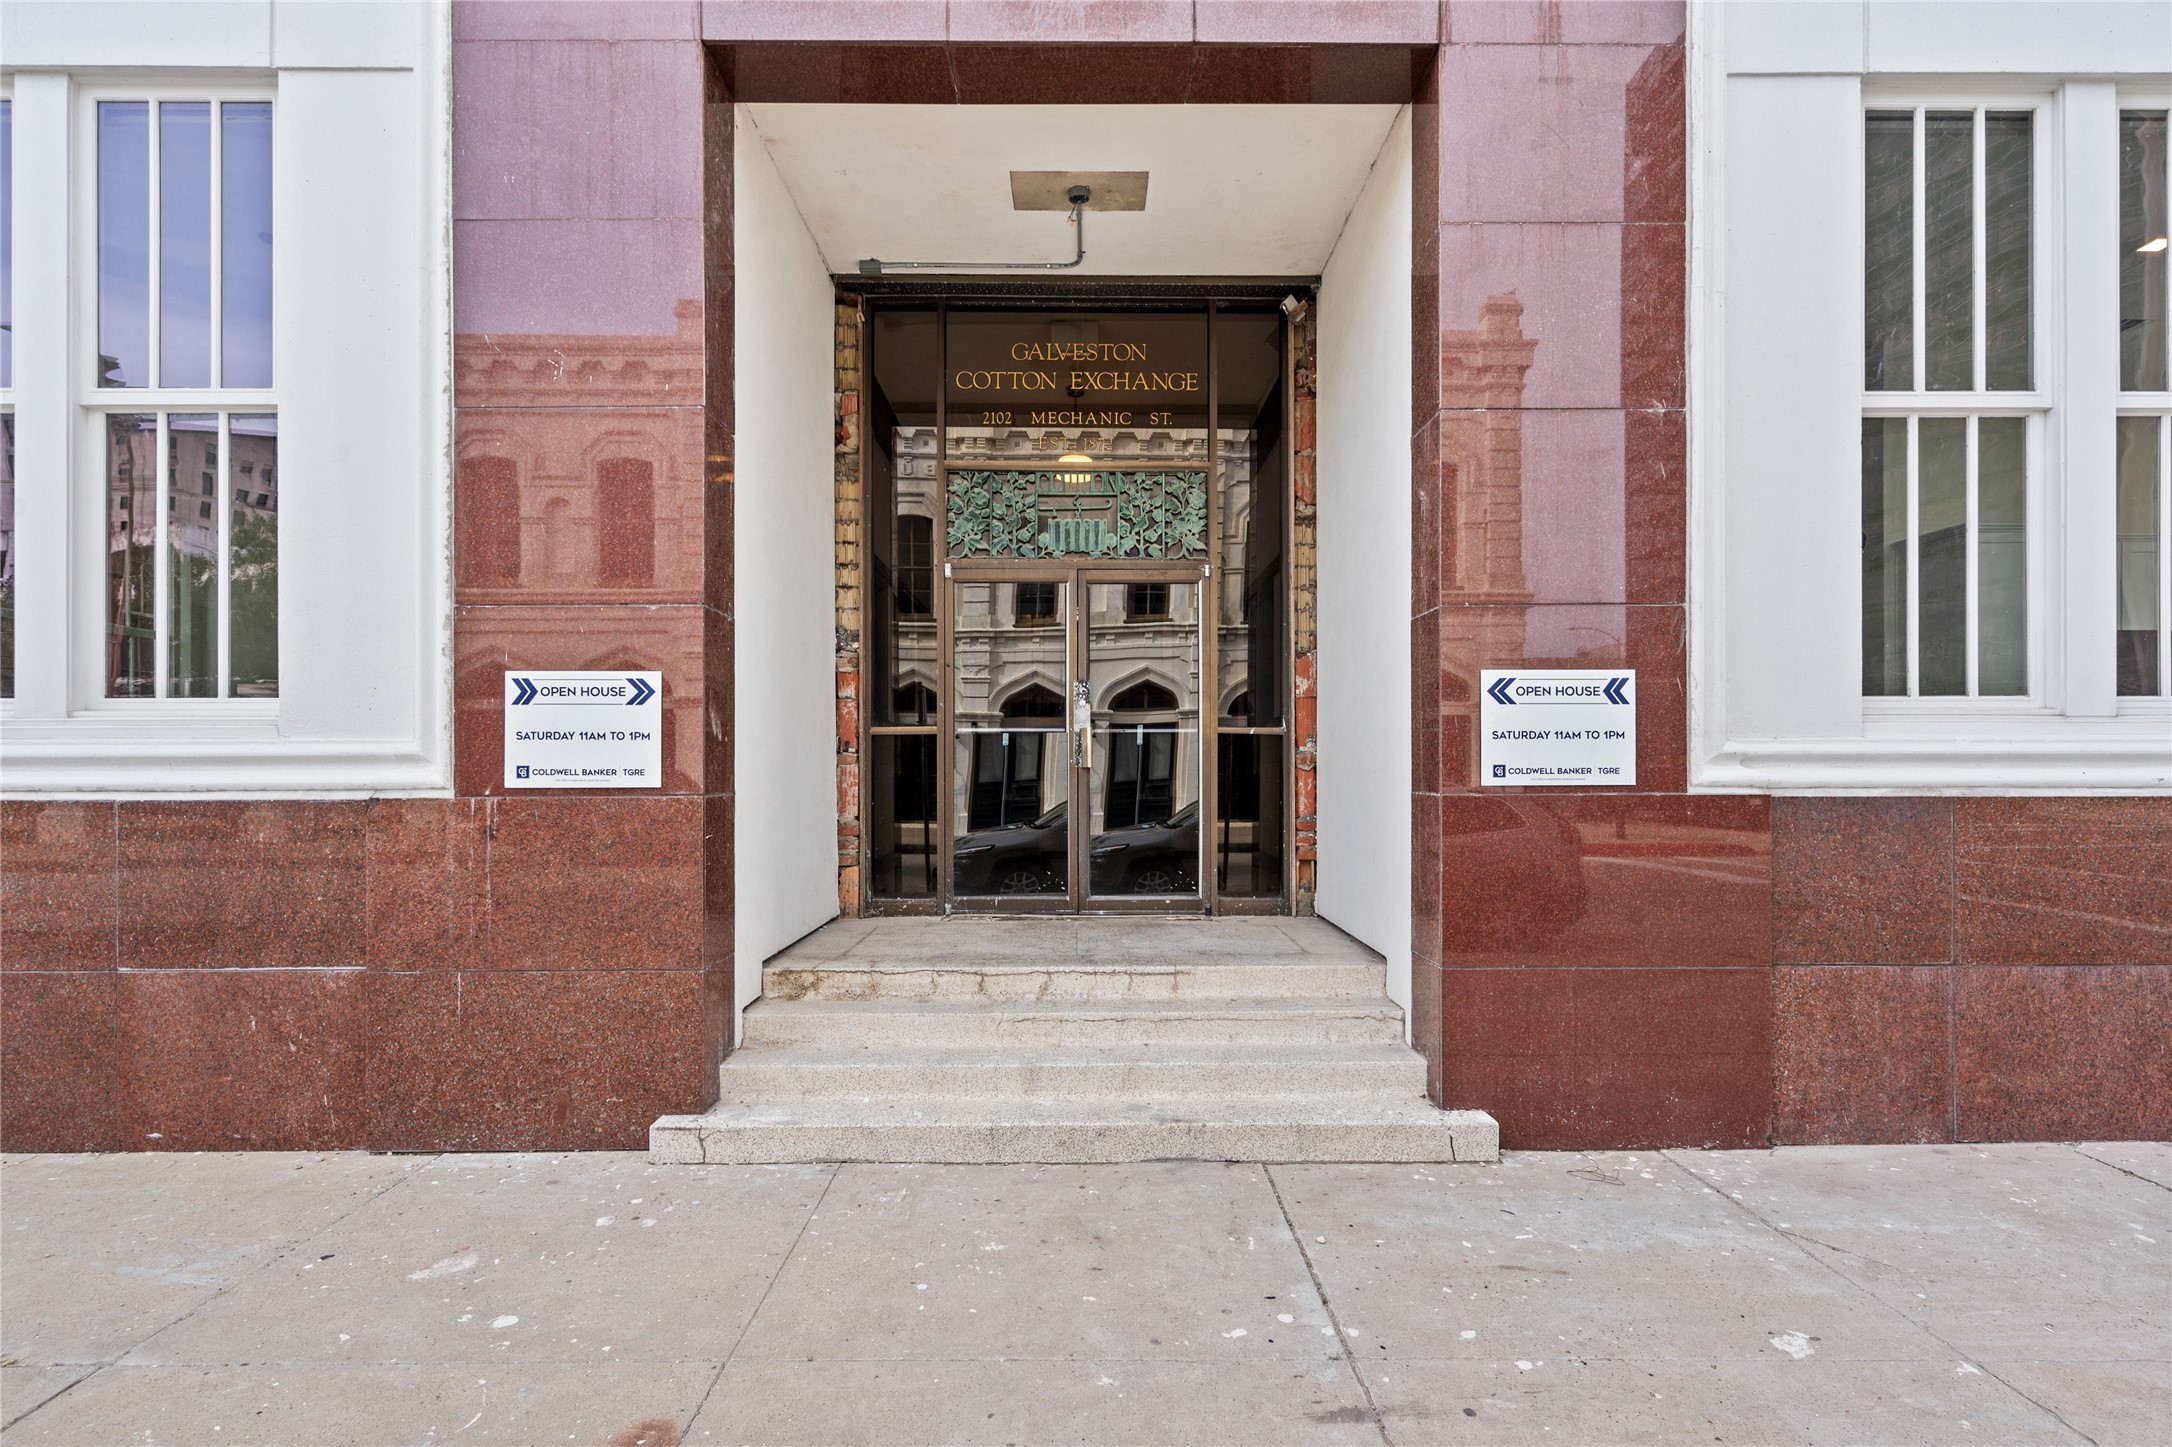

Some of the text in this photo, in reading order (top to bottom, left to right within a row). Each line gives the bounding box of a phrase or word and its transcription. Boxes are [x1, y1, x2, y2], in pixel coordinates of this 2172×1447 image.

[1011, 343, 1146, 361] GALVESTON
[956, 371, 1198, 391] COTTON EXCHANGE
[983, 411, 1173, 425] 2102 MECHANIC ST.
[1039, 437, 1072, 450] EST.
[541, 687, 626, 696] OPEN HOUSE
[1516, 686, 1600, 696] OPEN HOUSE
[516, 732, 650, 740] SATURDAY 11AM TO 1PM
[1492, 731, 1624, 739] SATURDAY 11AM TO 1PM
